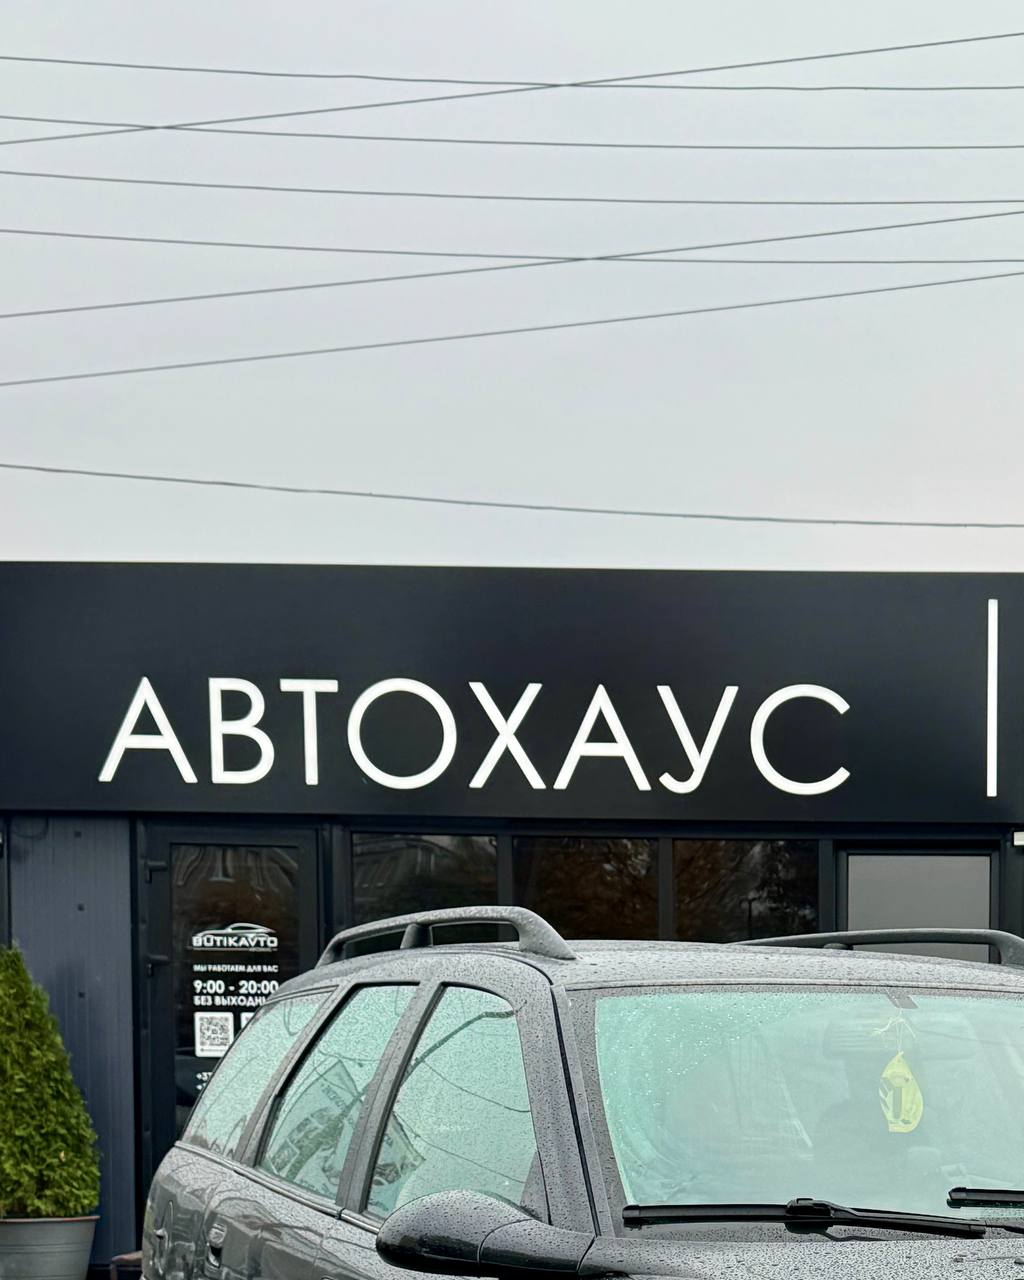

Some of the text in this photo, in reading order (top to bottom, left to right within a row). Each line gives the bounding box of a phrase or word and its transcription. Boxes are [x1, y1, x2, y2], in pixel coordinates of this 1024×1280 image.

[98, 676, 851, 795] АВТОХАУС
[192, 935, 278, 947] BUTIKAVTO
[193, 980, 225, 994] 9:00
[239, 980, 279, 994] 20:00
[193, 995, 212, 1006] БЕЗ
